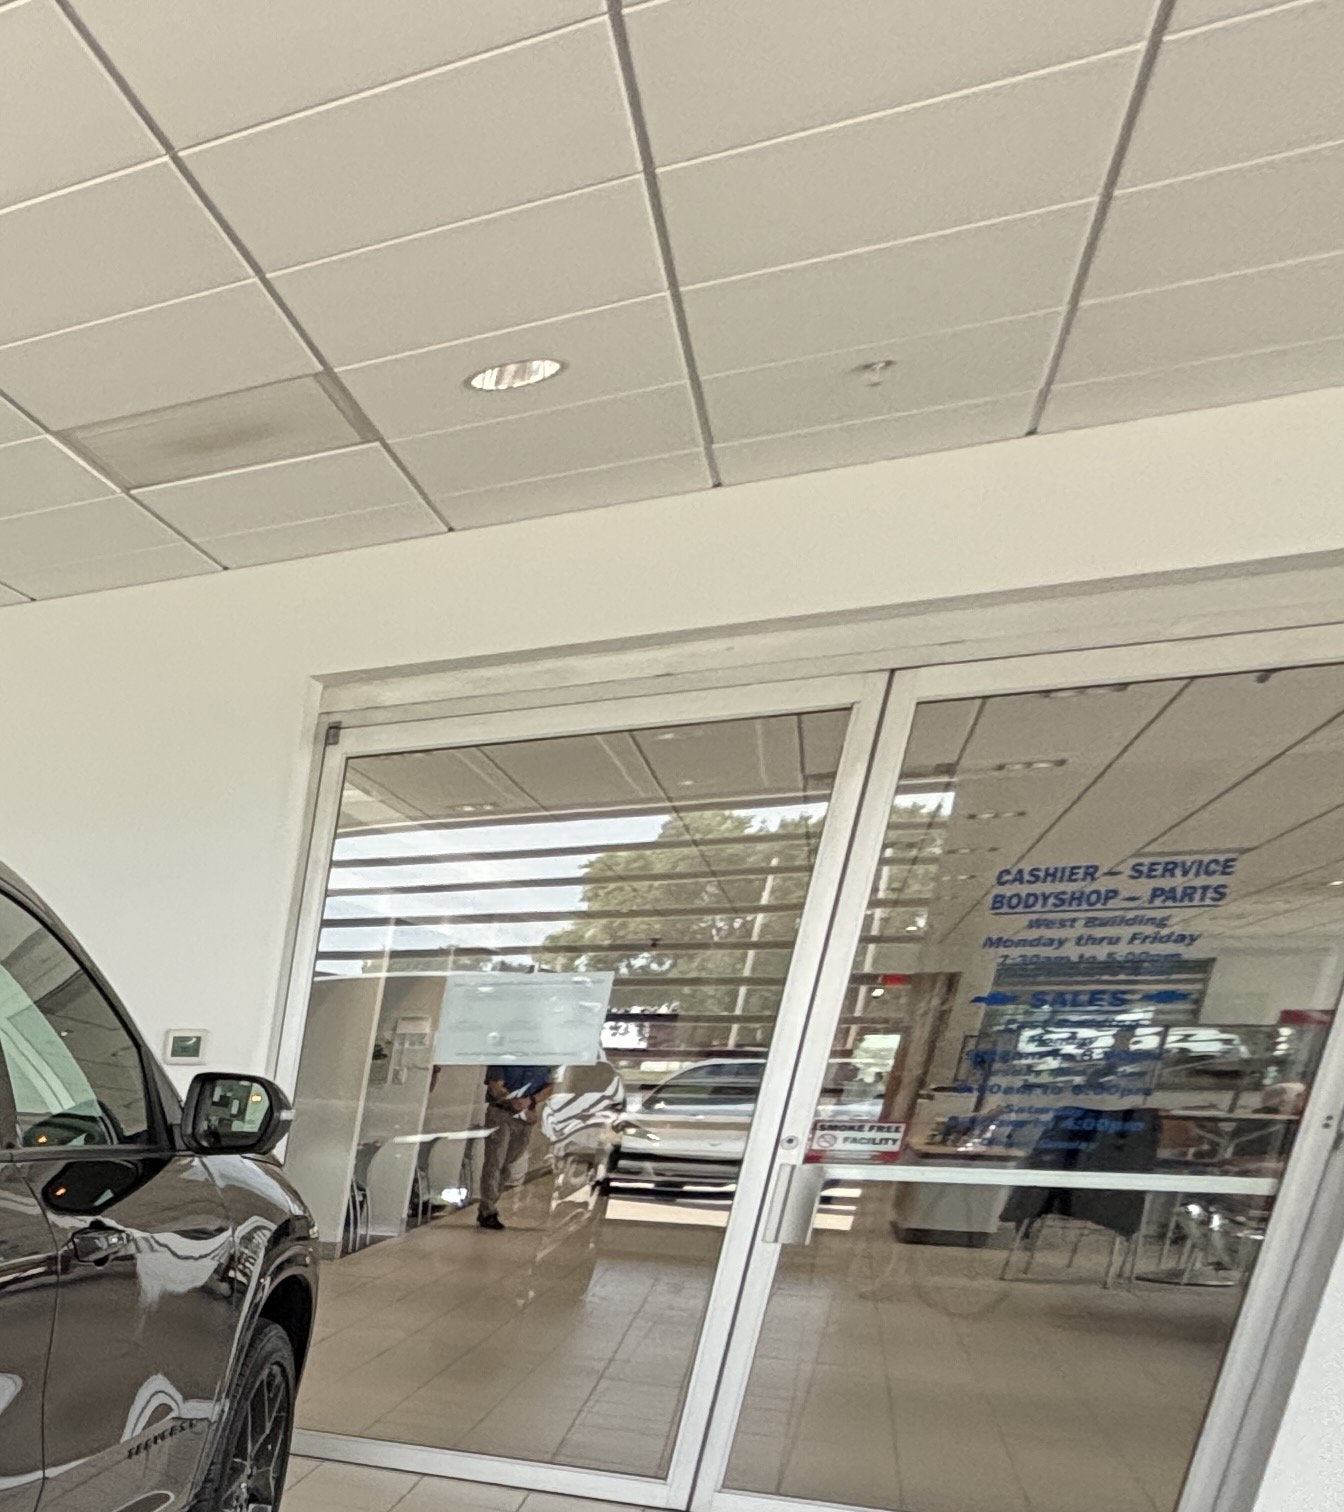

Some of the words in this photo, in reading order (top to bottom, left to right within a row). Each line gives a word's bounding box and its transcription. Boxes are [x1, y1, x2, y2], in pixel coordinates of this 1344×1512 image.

[996, 864, 1100, 887] CASHIER
[1127, 857, 1238, 880] SERVICE
[990, 888, 1119, 911] BODYSHOP
[1147, 884, 1229, 904] PARTS
[1027, 915, 1077, 930] West
[1083, 914, 1171, 929] Building
[983, 935, 1068, 949] Monday
[1075, 933, 1122, 946] thru
[1127, 931, 1201, 946] Friday
[1030, 990, 1130, 1008] SALES
[818, 1124, 865, 1132] SMOKE
[867, 1124, 902, 1133] FREE
[842, 1136, 900, 1146] FACILITY
